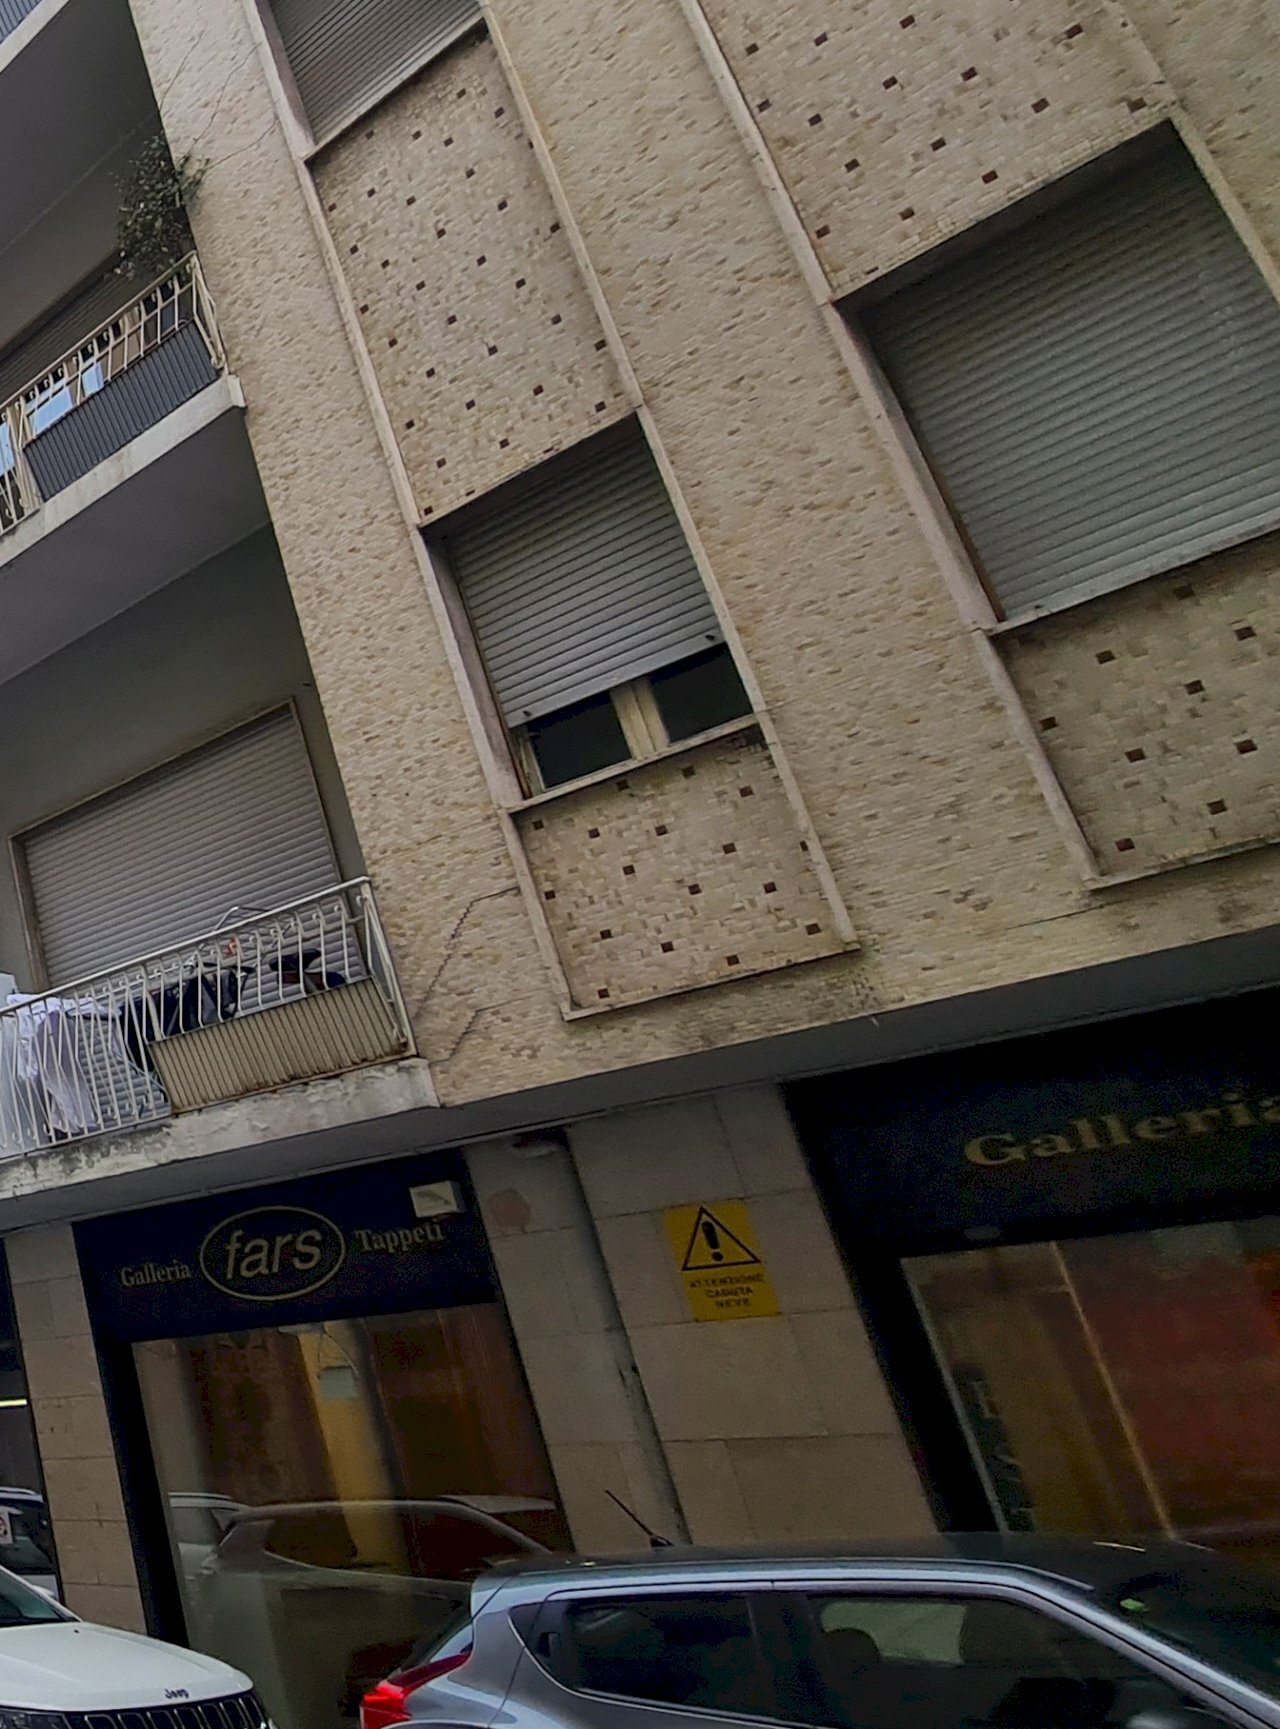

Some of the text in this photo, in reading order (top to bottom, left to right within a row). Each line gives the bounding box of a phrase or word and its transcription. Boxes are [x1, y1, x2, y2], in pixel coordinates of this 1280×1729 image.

[120, 1221, 448, 1288] Galleria fars Tappeti
